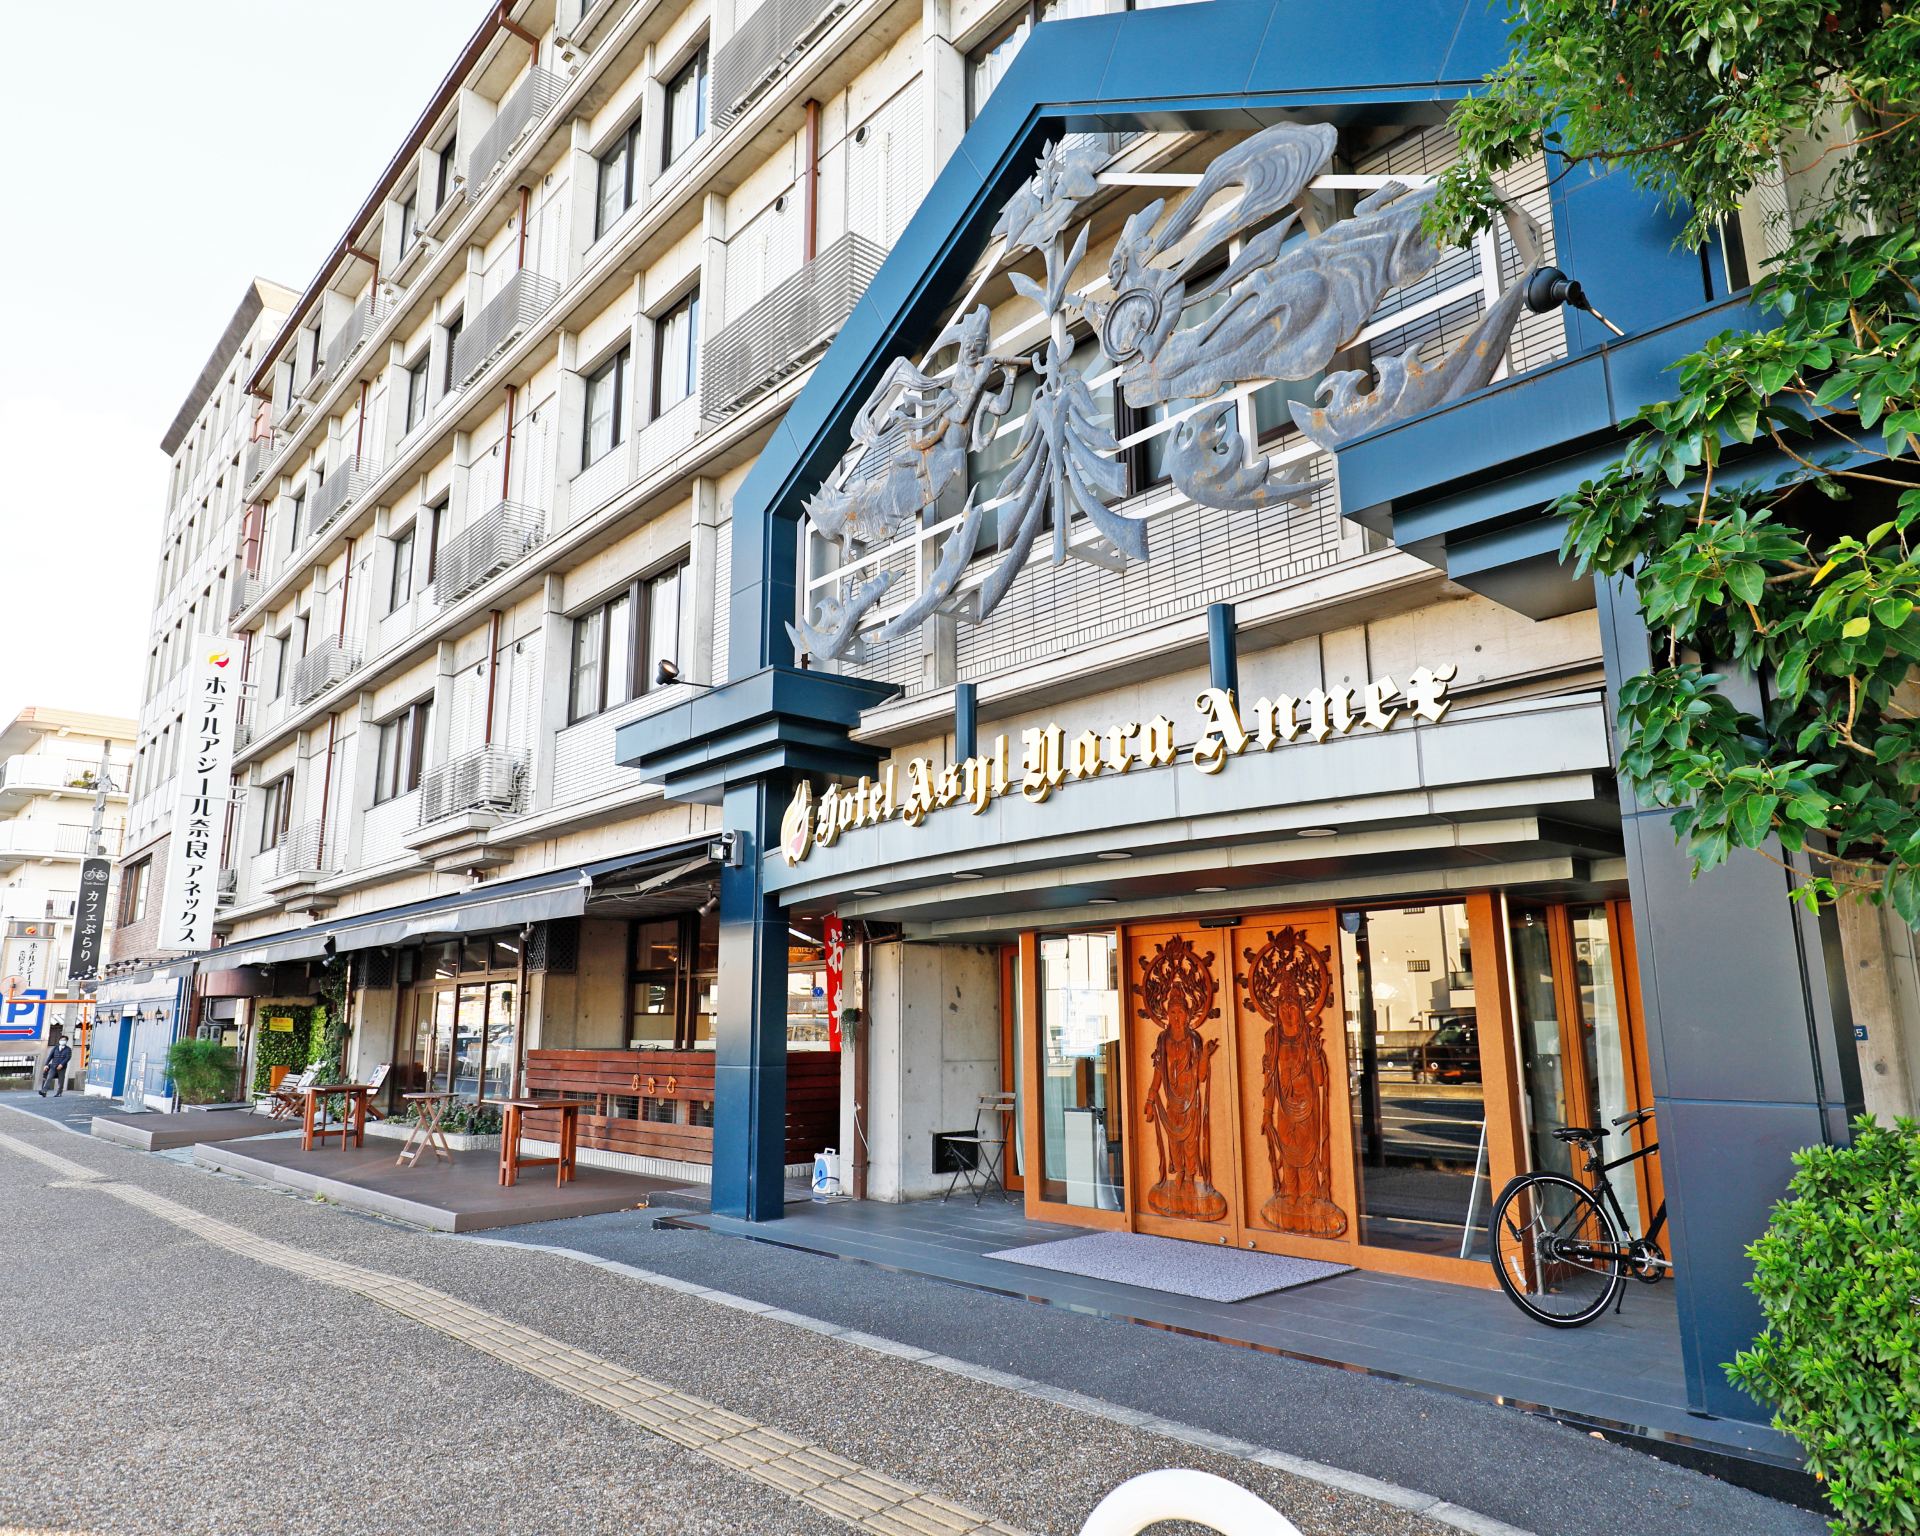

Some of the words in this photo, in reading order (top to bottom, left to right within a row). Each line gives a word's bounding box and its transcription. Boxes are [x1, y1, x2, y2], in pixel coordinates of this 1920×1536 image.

[816, 764, 898, 848] Hotel
[903, 735, 1011, 827] Asyl
[1022, 714, 1178, 803] Nara
[1192, 663, 1458, 775] Annex
[80, 890, 99, 961] カフェぶらり
[6, 998, 35, 1023] P
